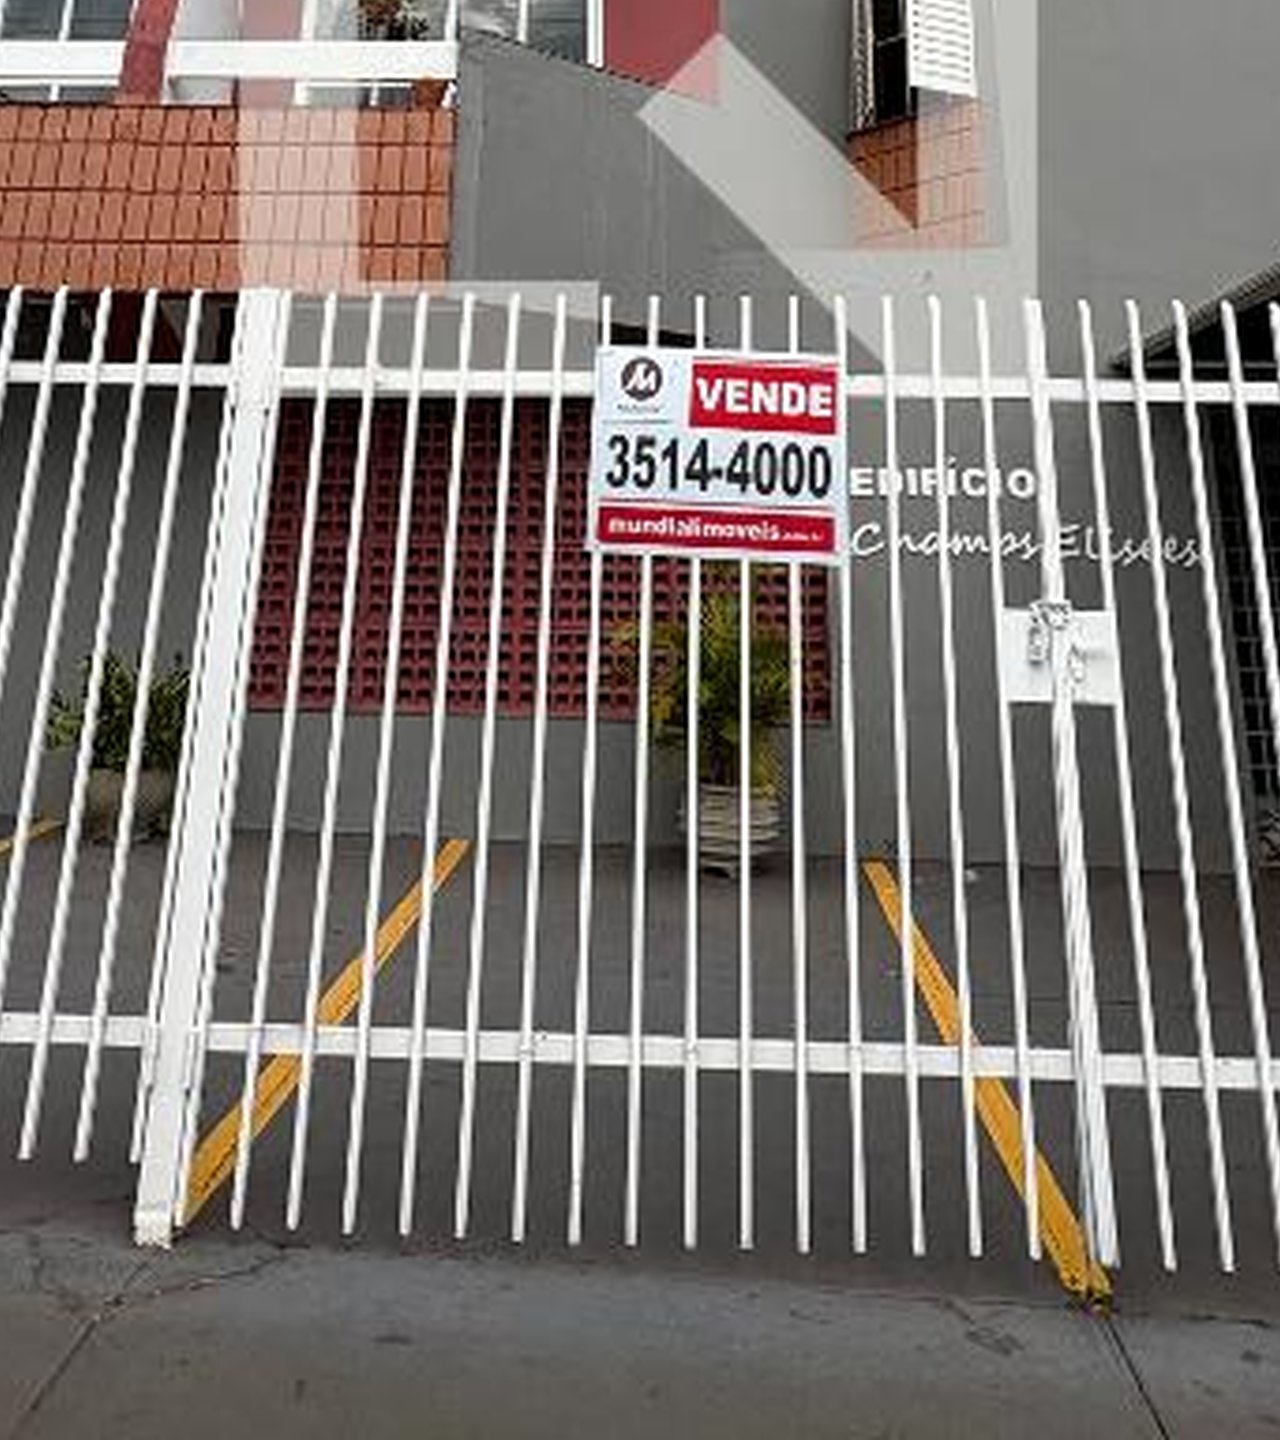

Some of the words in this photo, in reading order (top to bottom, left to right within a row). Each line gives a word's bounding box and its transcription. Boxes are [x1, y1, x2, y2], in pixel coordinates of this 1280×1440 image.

[696, 377, 833, 417] VENDE
[606, 434, 832, 499] 3514-4000
[849, 456, 1035, 498] EDIFÍCIO
